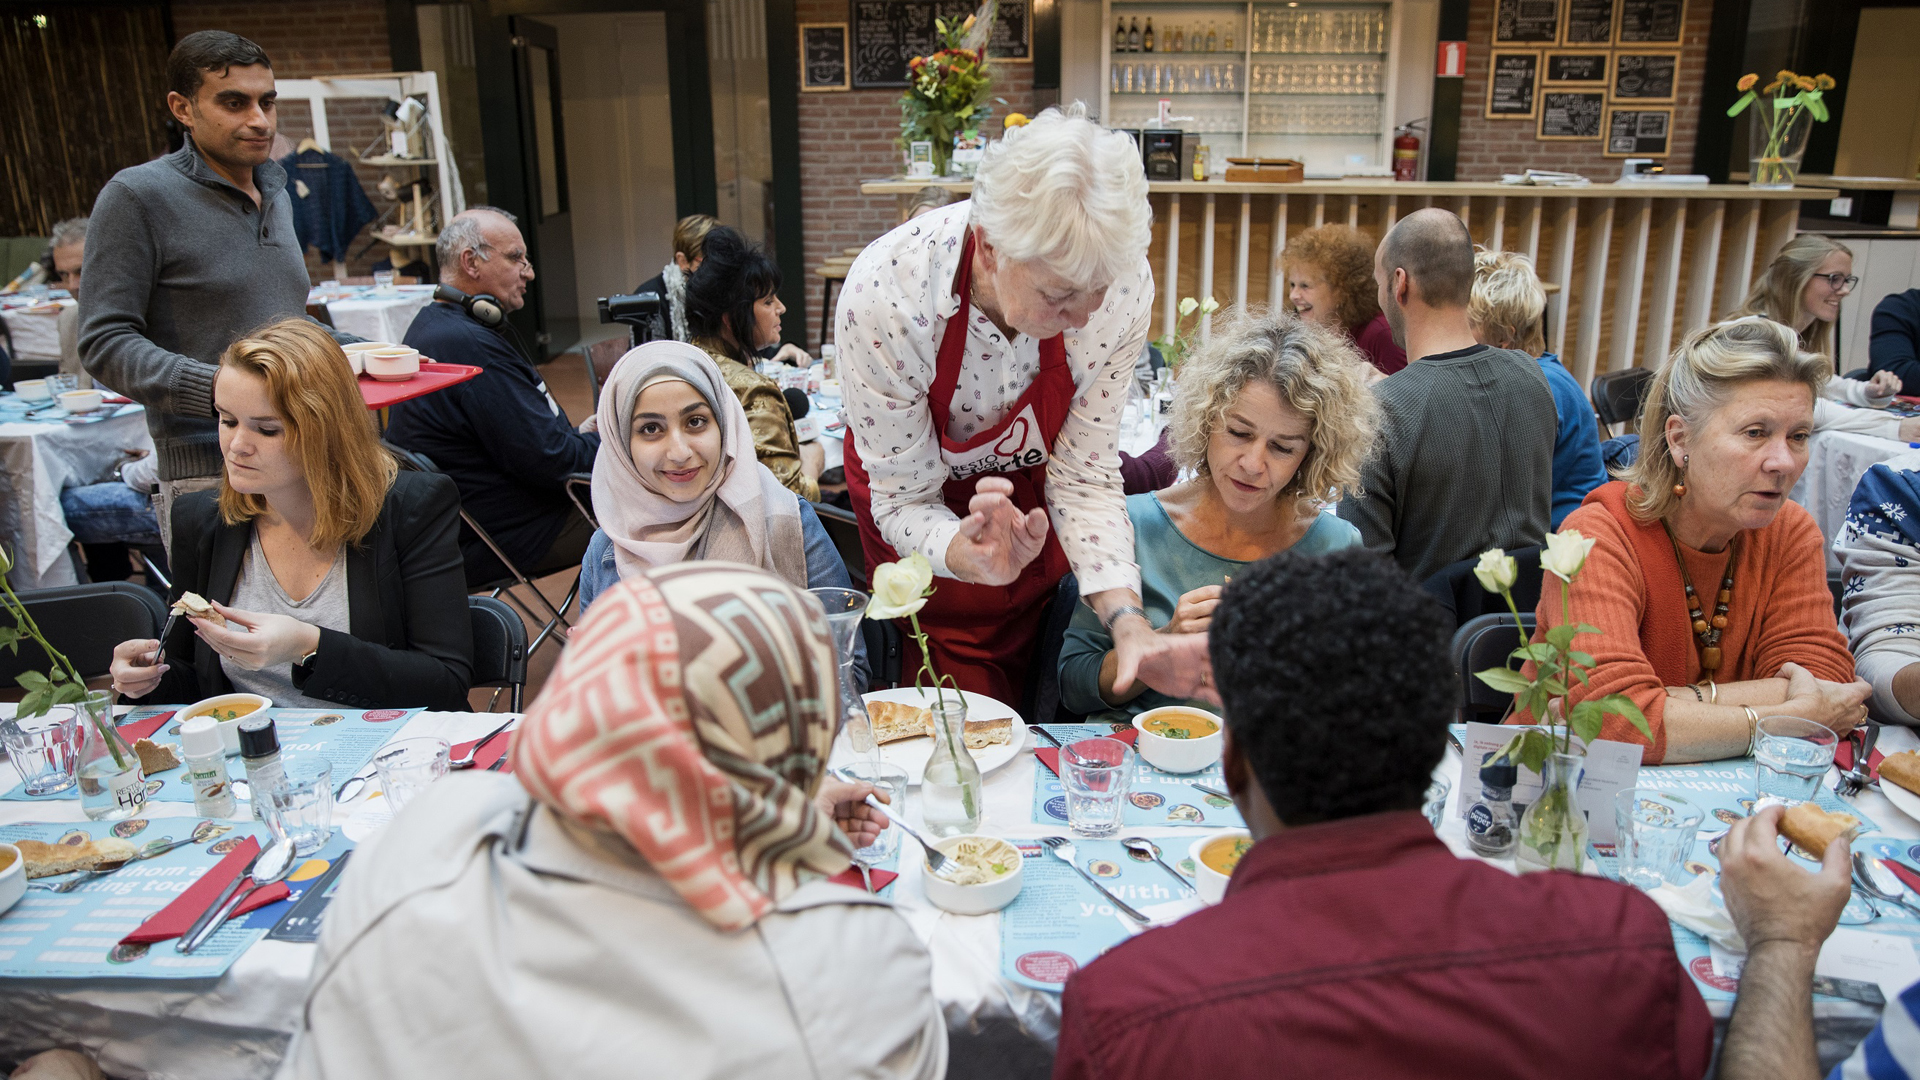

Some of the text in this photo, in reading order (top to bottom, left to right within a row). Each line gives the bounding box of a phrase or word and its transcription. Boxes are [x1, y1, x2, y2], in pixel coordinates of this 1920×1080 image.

[951, 454, 998, 472] RESTO
[952, 448, 1042, 479] Hrte
[977, 461, 1000, 471] van
[1638, 768, 1751, 780] you eatin
[116, 781, 139, 797] RESTO
[1636, 780, 1749, 794] With wh
[118, 786, 146, 809] Har
[1470, 812, 1491, 827] peper
[142, 879, 198, 893] tod
[1080, 902, 1119, 917] yo
